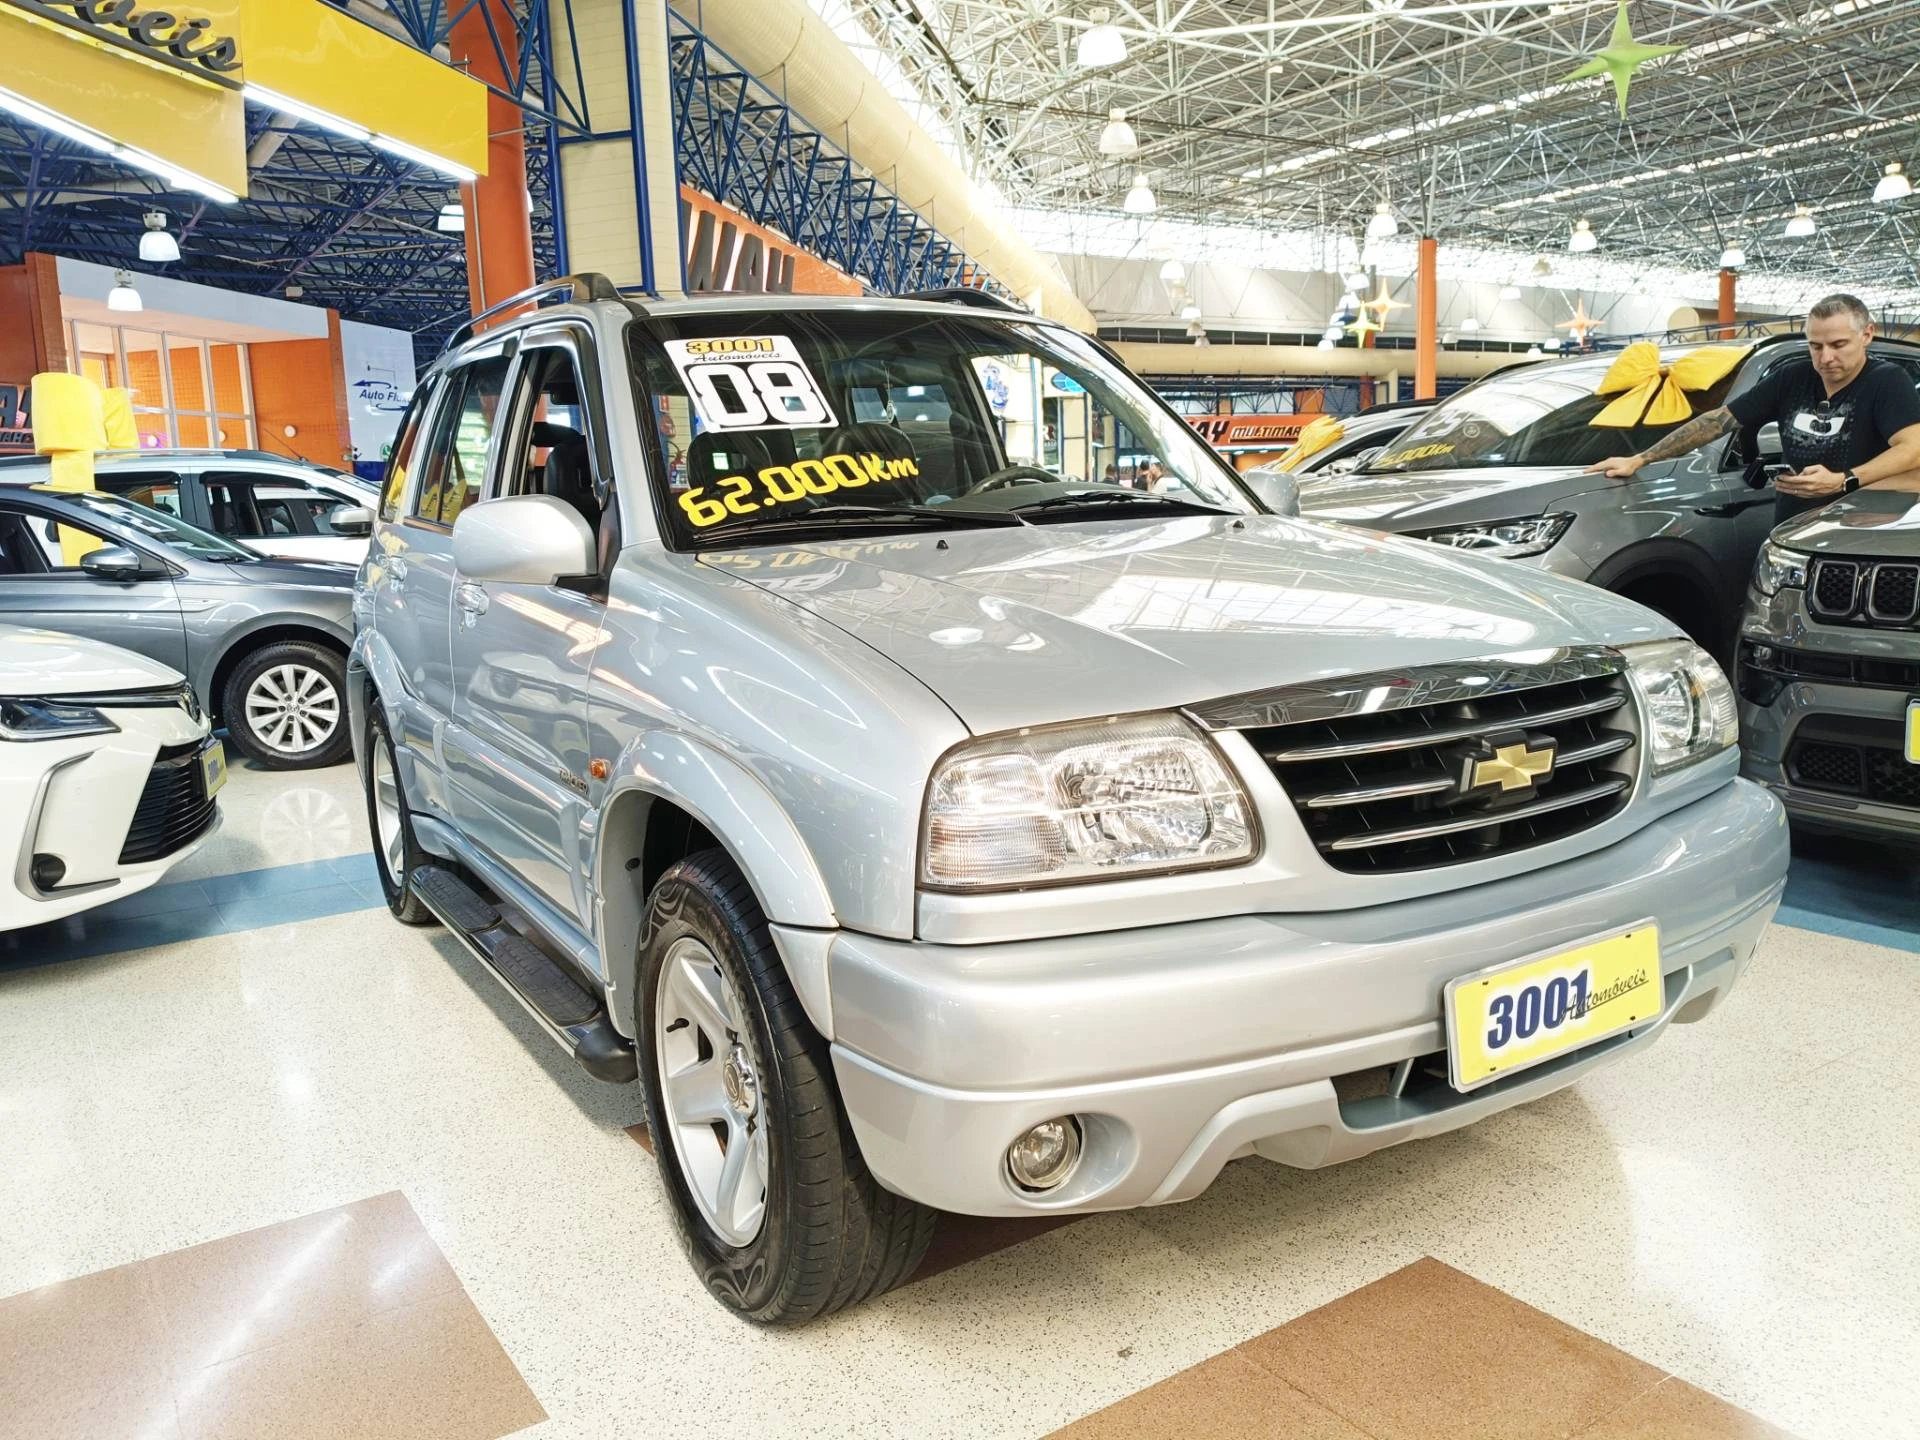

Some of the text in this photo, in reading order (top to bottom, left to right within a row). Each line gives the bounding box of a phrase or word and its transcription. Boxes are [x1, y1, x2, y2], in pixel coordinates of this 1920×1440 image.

[70, 0, 243, 72] veis
[686, 337, 775, 355] 3001
[360, 389, 385, 401] Auto
[686, 362, 828, 427] 08
[1187, 420, 1302, 443] AY MULTIMAR
[1487, 967, 1649, 1050] 3001 Automóveis
